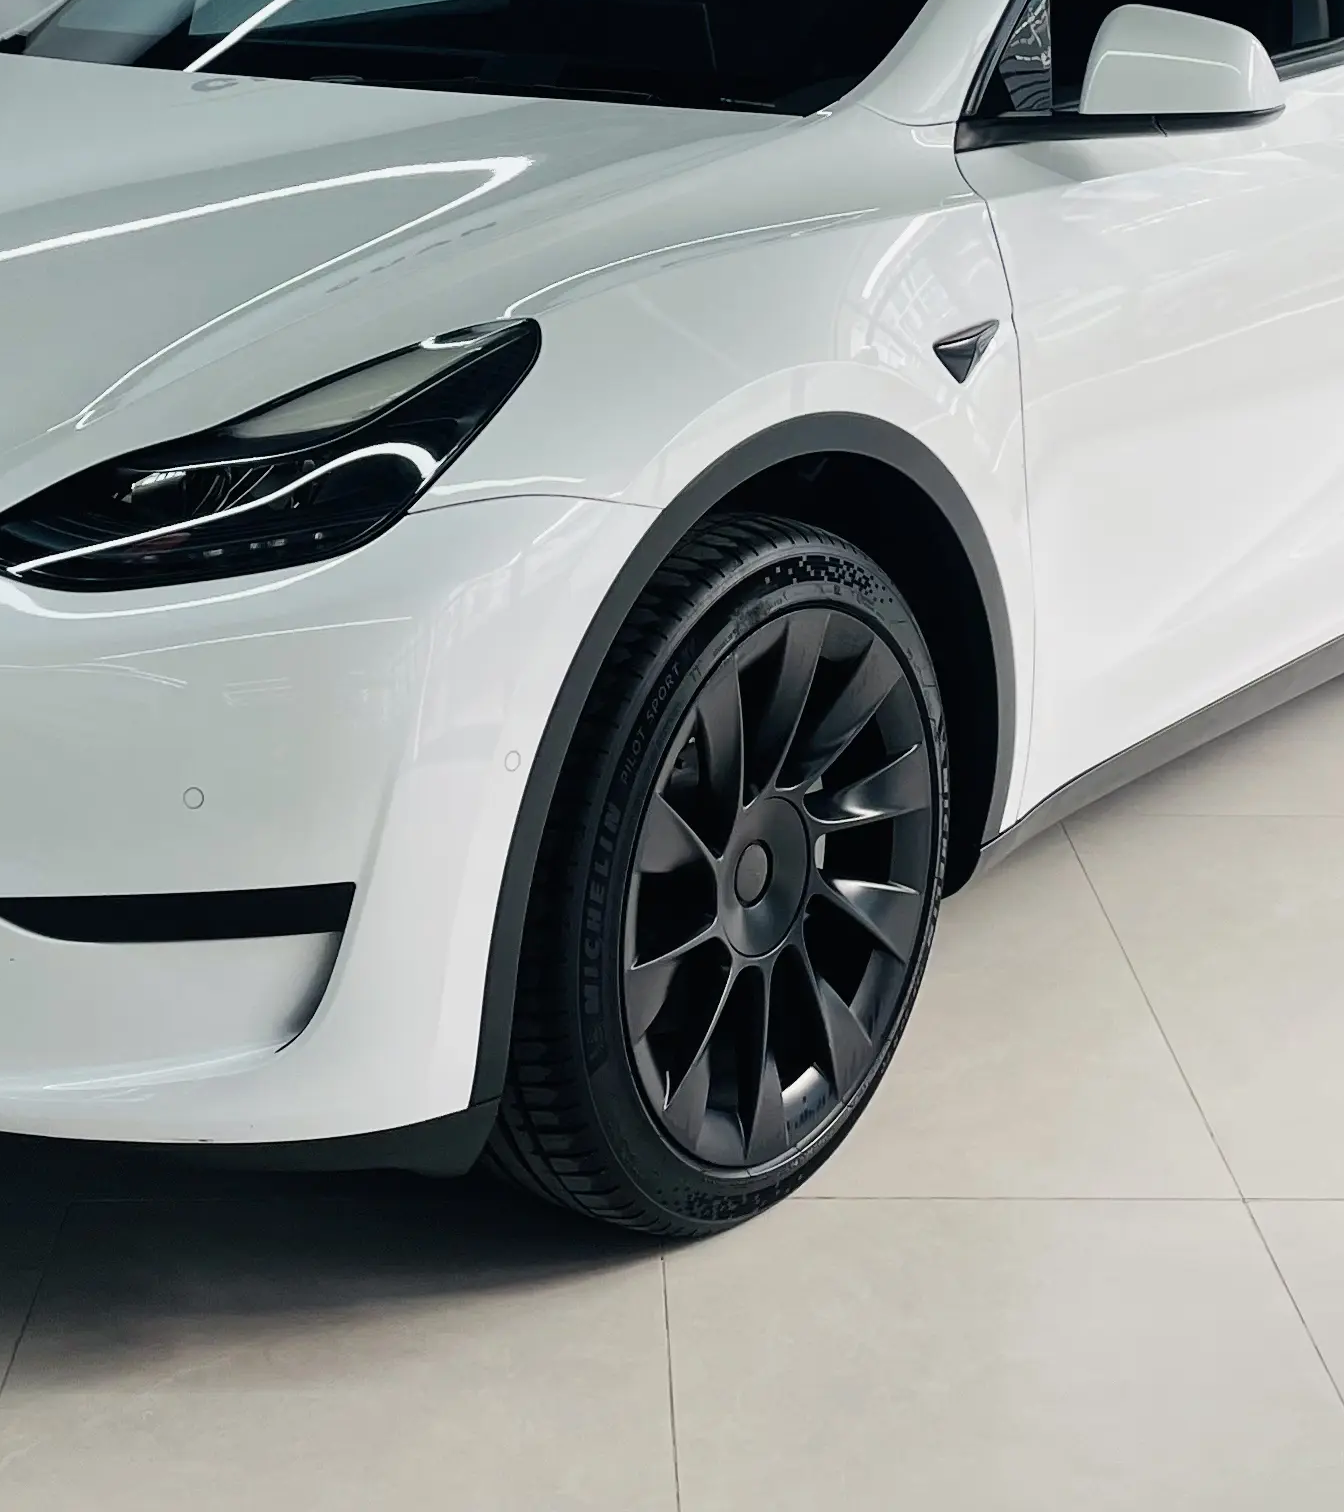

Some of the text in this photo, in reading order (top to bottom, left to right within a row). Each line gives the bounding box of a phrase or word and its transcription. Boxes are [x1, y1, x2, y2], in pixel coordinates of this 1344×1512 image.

[583, 659, 681, 1015] MICHELIN PILOT SPORT
